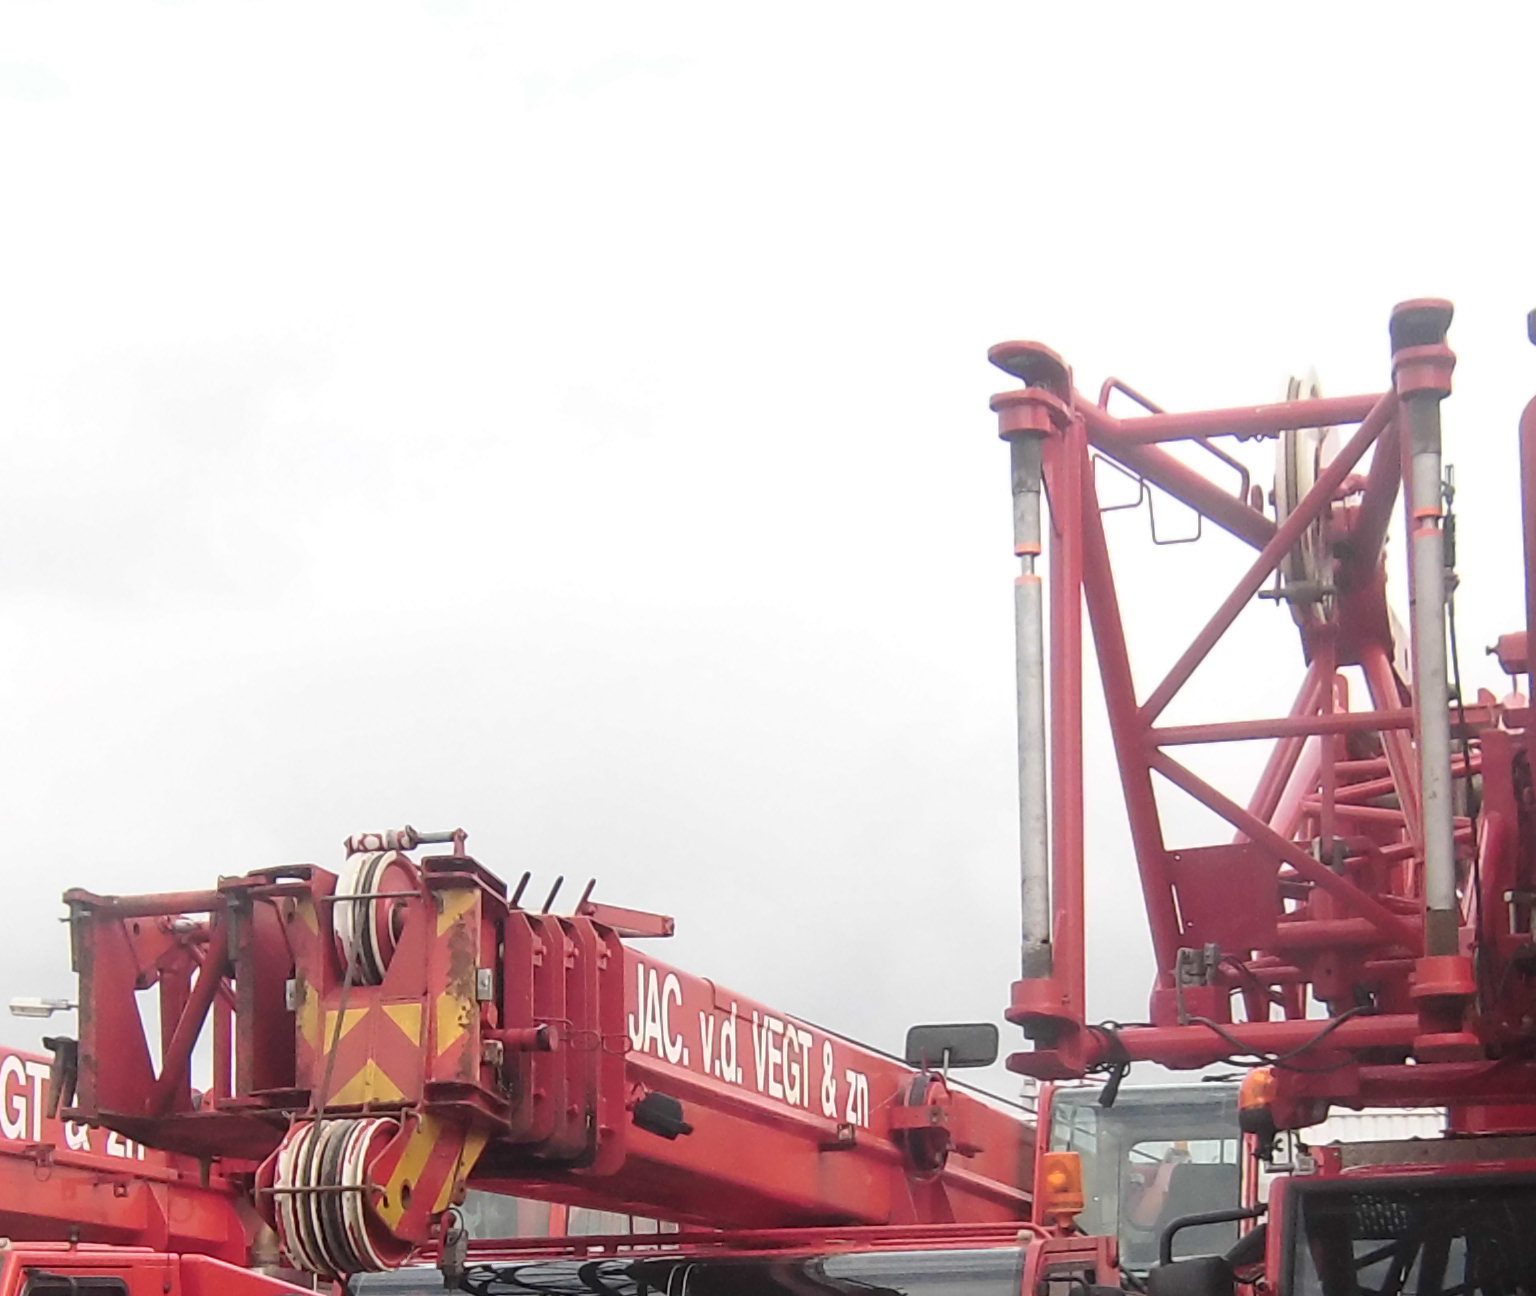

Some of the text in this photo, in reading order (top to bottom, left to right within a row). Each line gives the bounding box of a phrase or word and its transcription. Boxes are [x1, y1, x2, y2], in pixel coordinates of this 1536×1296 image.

[628, 962, 869, 1129] JAC. v.d. VEGT & zn
